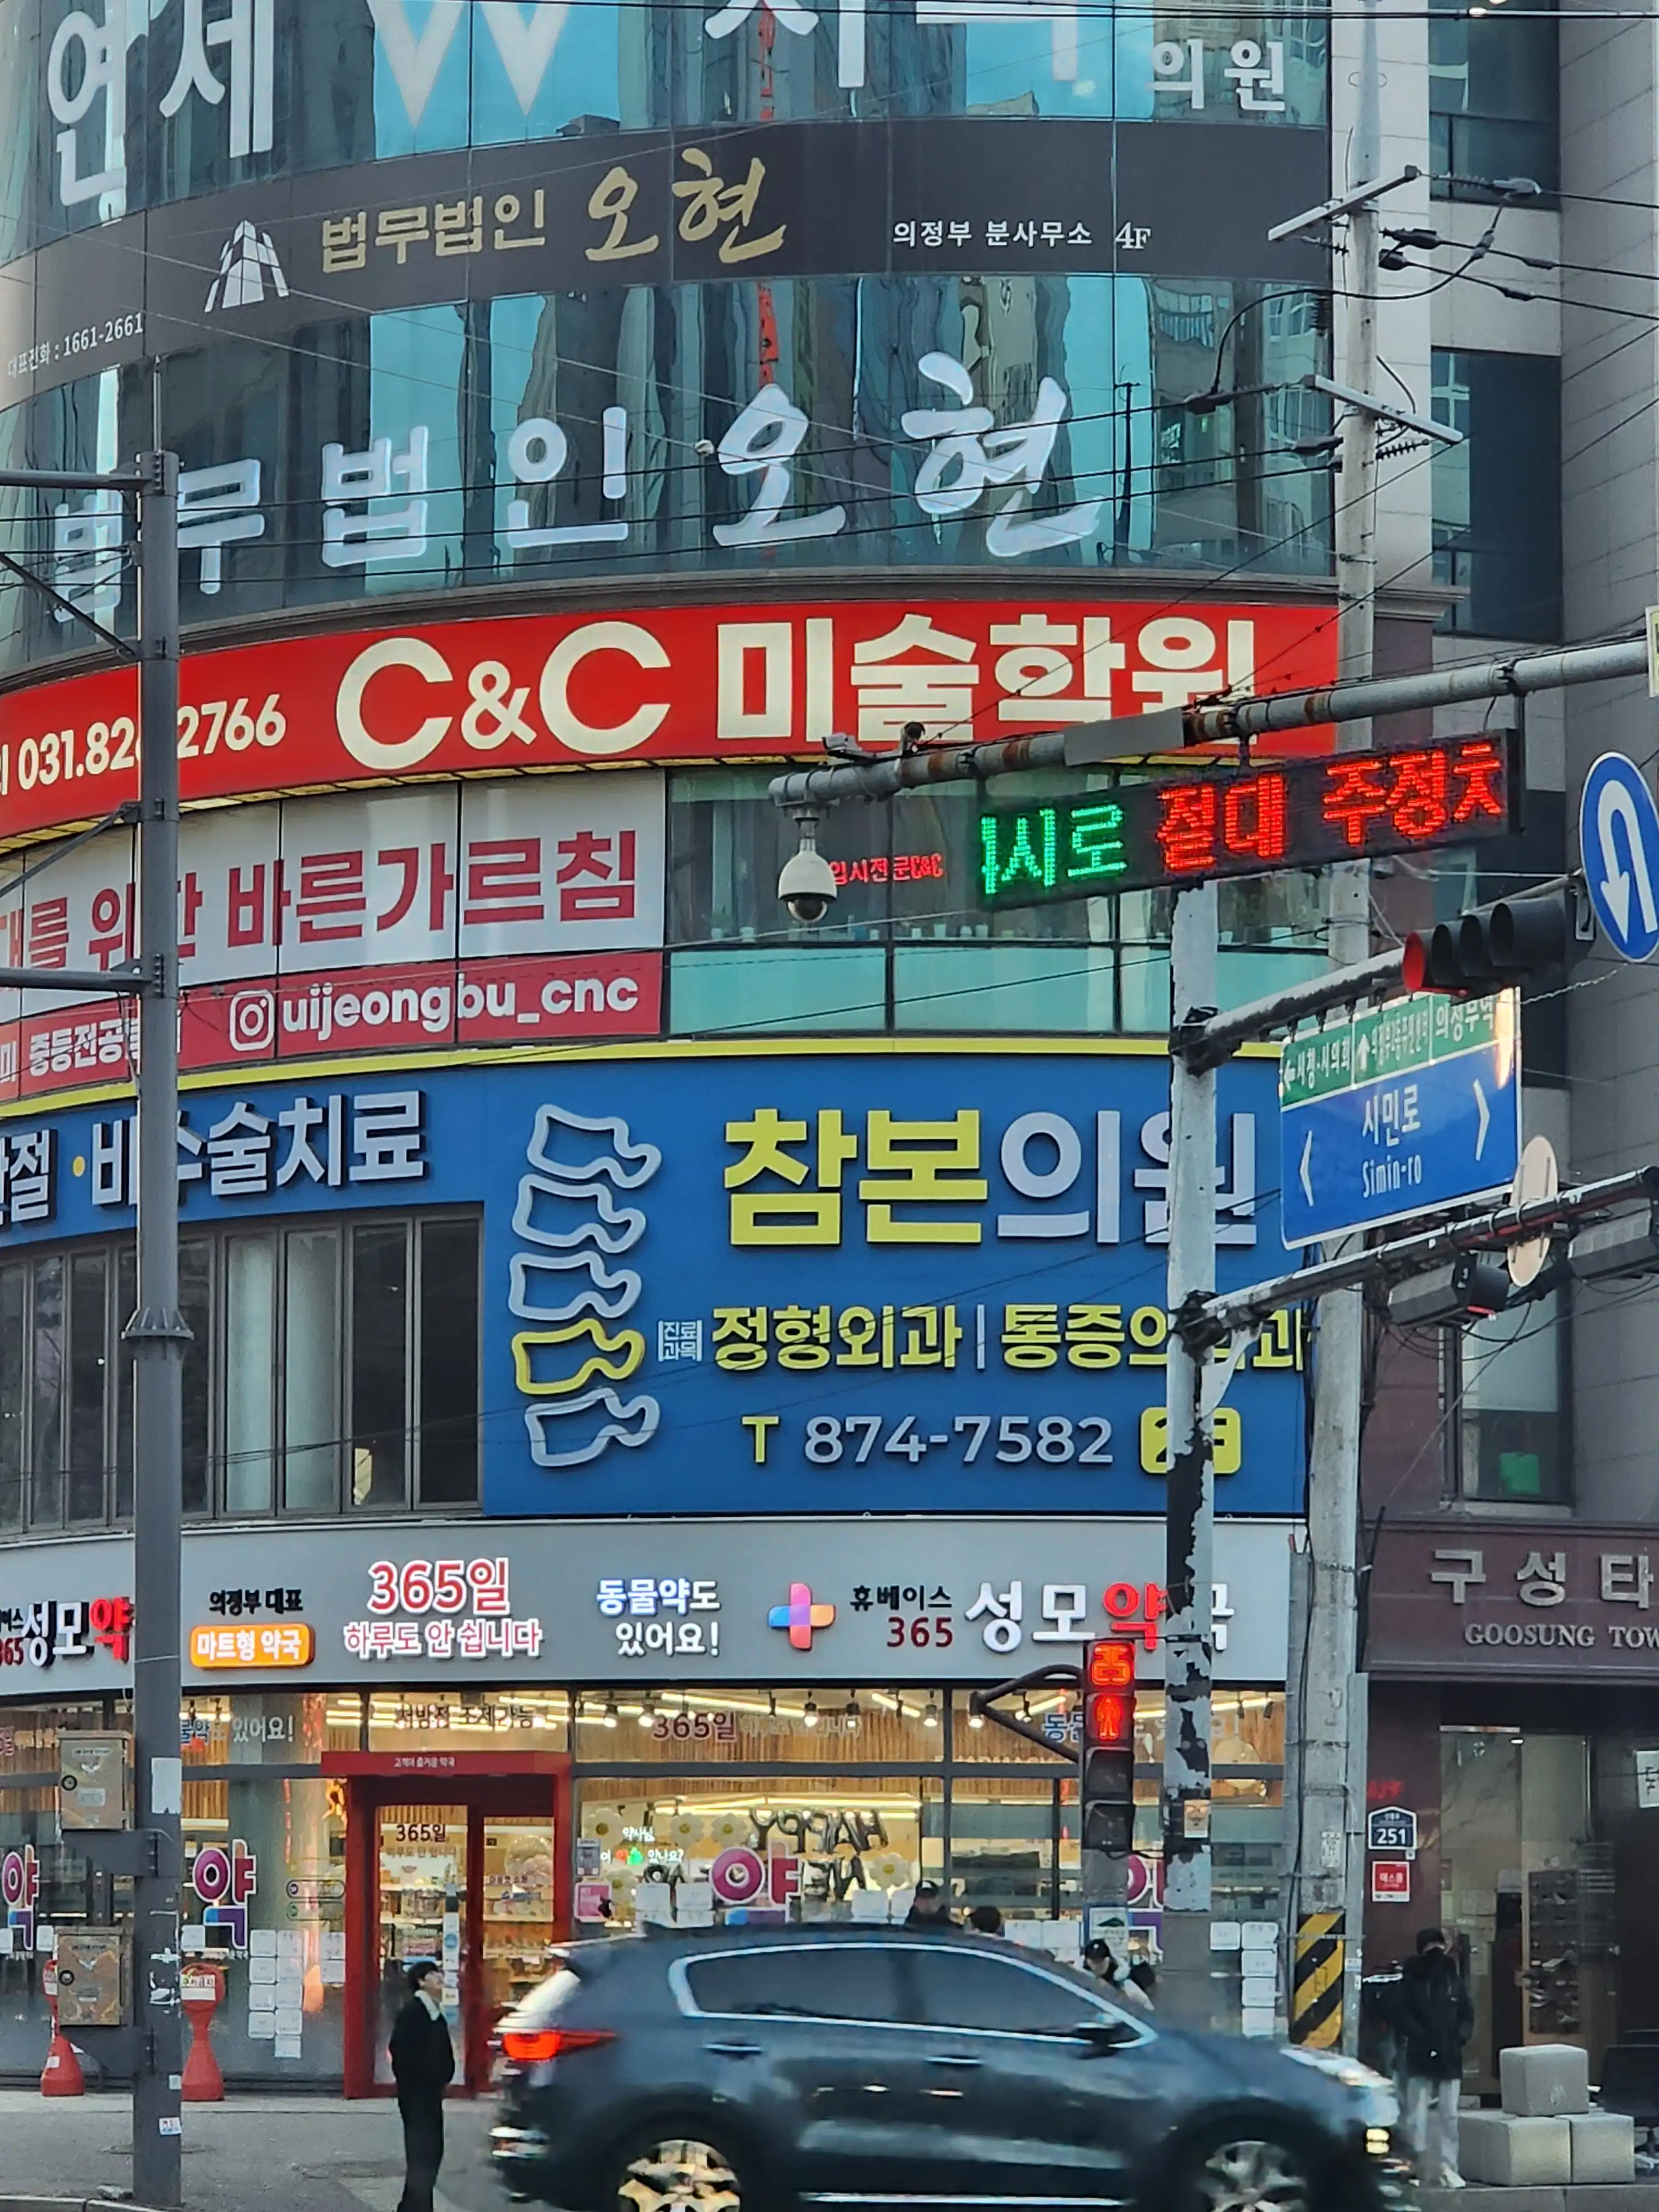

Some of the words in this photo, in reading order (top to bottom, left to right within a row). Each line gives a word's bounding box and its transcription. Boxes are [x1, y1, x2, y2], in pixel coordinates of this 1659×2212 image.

[1146, 39, 1286, 111] 의원
[322, 190, 545, 273] 법무법인
[585, 147, 786, 264] 오현
[893, 221, 972, 247] 의정부
[985, 221, 1092, 247] 분사무소
[1114, 226, 1151, 249] 4F
[64, 314, 143, 357] 1661-2661
[54, 406, 629, 623] 법무법인
[712, 351, 1104, 557] 오현
[336, 621, 671, 770] C&C
[717, 614, 1255, 744] 미술학원
[1157, 775, 1285, 872] 절대
[227, 831, 636, 948] 바른가르침
[283, 974, 638, 1041] uijeongbu_cnc
[1362, 1084, 1420, 1147] 시민로
[724, 1108, 1258, 1245] 참본의원
[1362, 1154, 1422, 1199] Simin-ro
[712, 1306, 962, 1369] 정형외과
[742, 1416, 779, 1463] T
[805, 1416, 1114, 1463] 874-7582
[210, 1589, 262, 1616] 의정부
[265, 1587, 303, 1615] 대표
[367, 1557, 509, 1615] 365일
[596, 1579, 721, 1615] 동물약도
[849, 1585, 952, 1612] 휴베이스
[1431, 1550, 1654, 1609] 구성타
[197, 1630, 255, 1661] 마트형
[261, 1629, 302, 1661] 약국
[344, 1622, 420, 1659] 하루도
[425, 1621, 453, 1655] 안
[457, 1618, 542, 1658] 쉽니다
[615, 1621, 719, 1656] 있어요!
[886, 1617, 953, 1647] 365
[1464, 1623, 1595, 1647] GOOSUNG
[232, 1715, 294, 1743] 있어요!
[653, 1711, 737, 1742] 365일
[396, 1824, 447, 1843] 365일
[1376, 1828, 1406, 1845] 251
